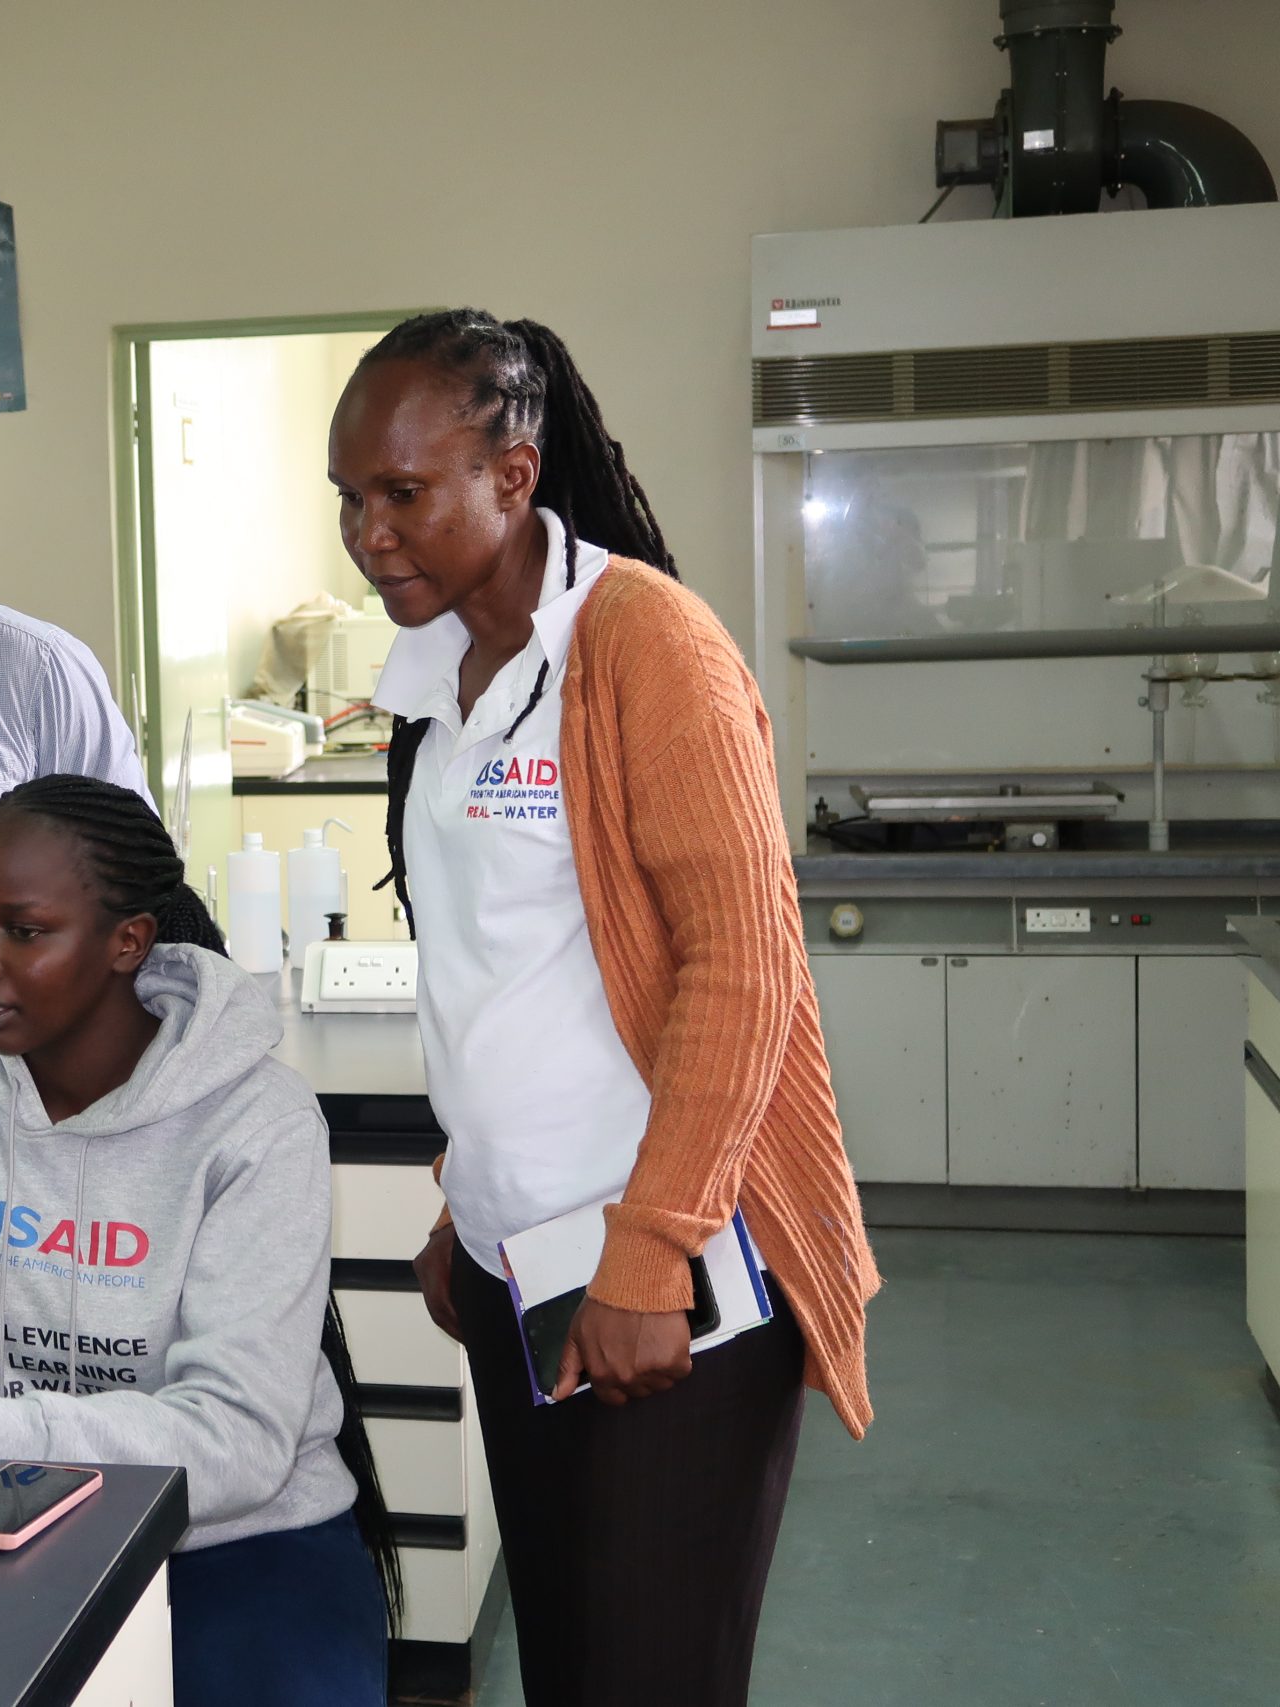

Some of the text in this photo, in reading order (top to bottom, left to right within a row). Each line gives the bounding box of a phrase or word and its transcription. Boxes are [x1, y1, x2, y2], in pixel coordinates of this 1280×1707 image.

[476, 756, 558, 786] USAID
[484, 790, 494, 799] THE
[495, 790, 526, 799] AMERICAN
[528, 790, 560, 800] PEOPLE
[466, 806, 490, 818] REAL
[504, 806, 558, 819] WATER
[22, 1259, 95, 1286] AMERICAN
[97, 1275, 146, 1290] PEOPLE
[22, 1326, 149, 1357] EVIDENCE
[8, 1352, 138, 1384] LEARNING
